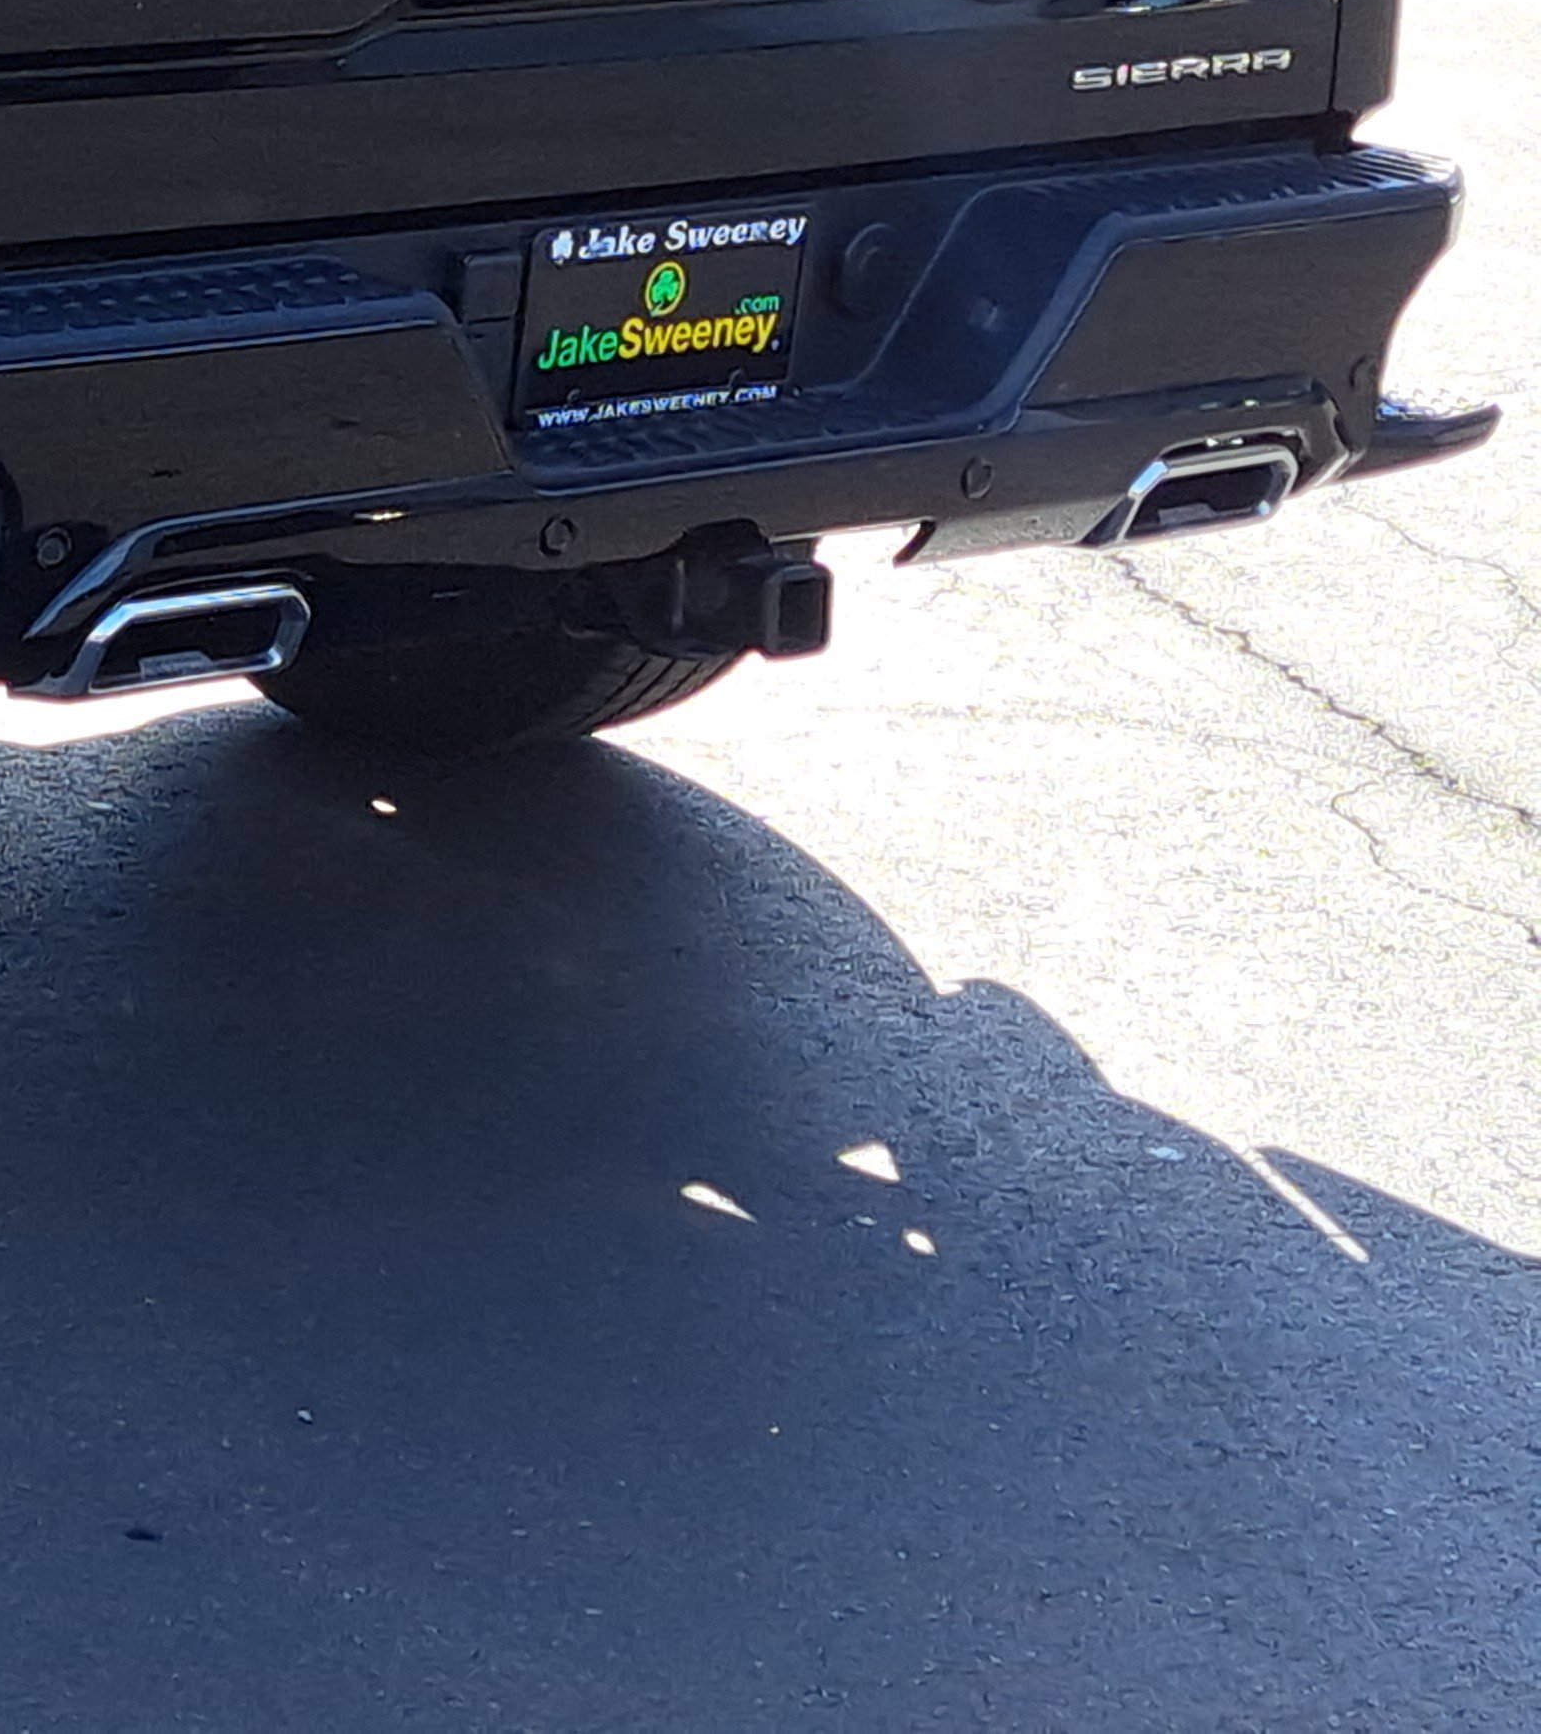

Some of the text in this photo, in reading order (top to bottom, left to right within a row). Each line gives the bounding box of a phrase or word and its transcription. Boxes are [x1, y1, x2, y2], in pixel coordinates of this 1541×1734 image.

[1071, 48, 1292, 93] SIERRA
[578, 213, 808, 261] Jake Sweeney
